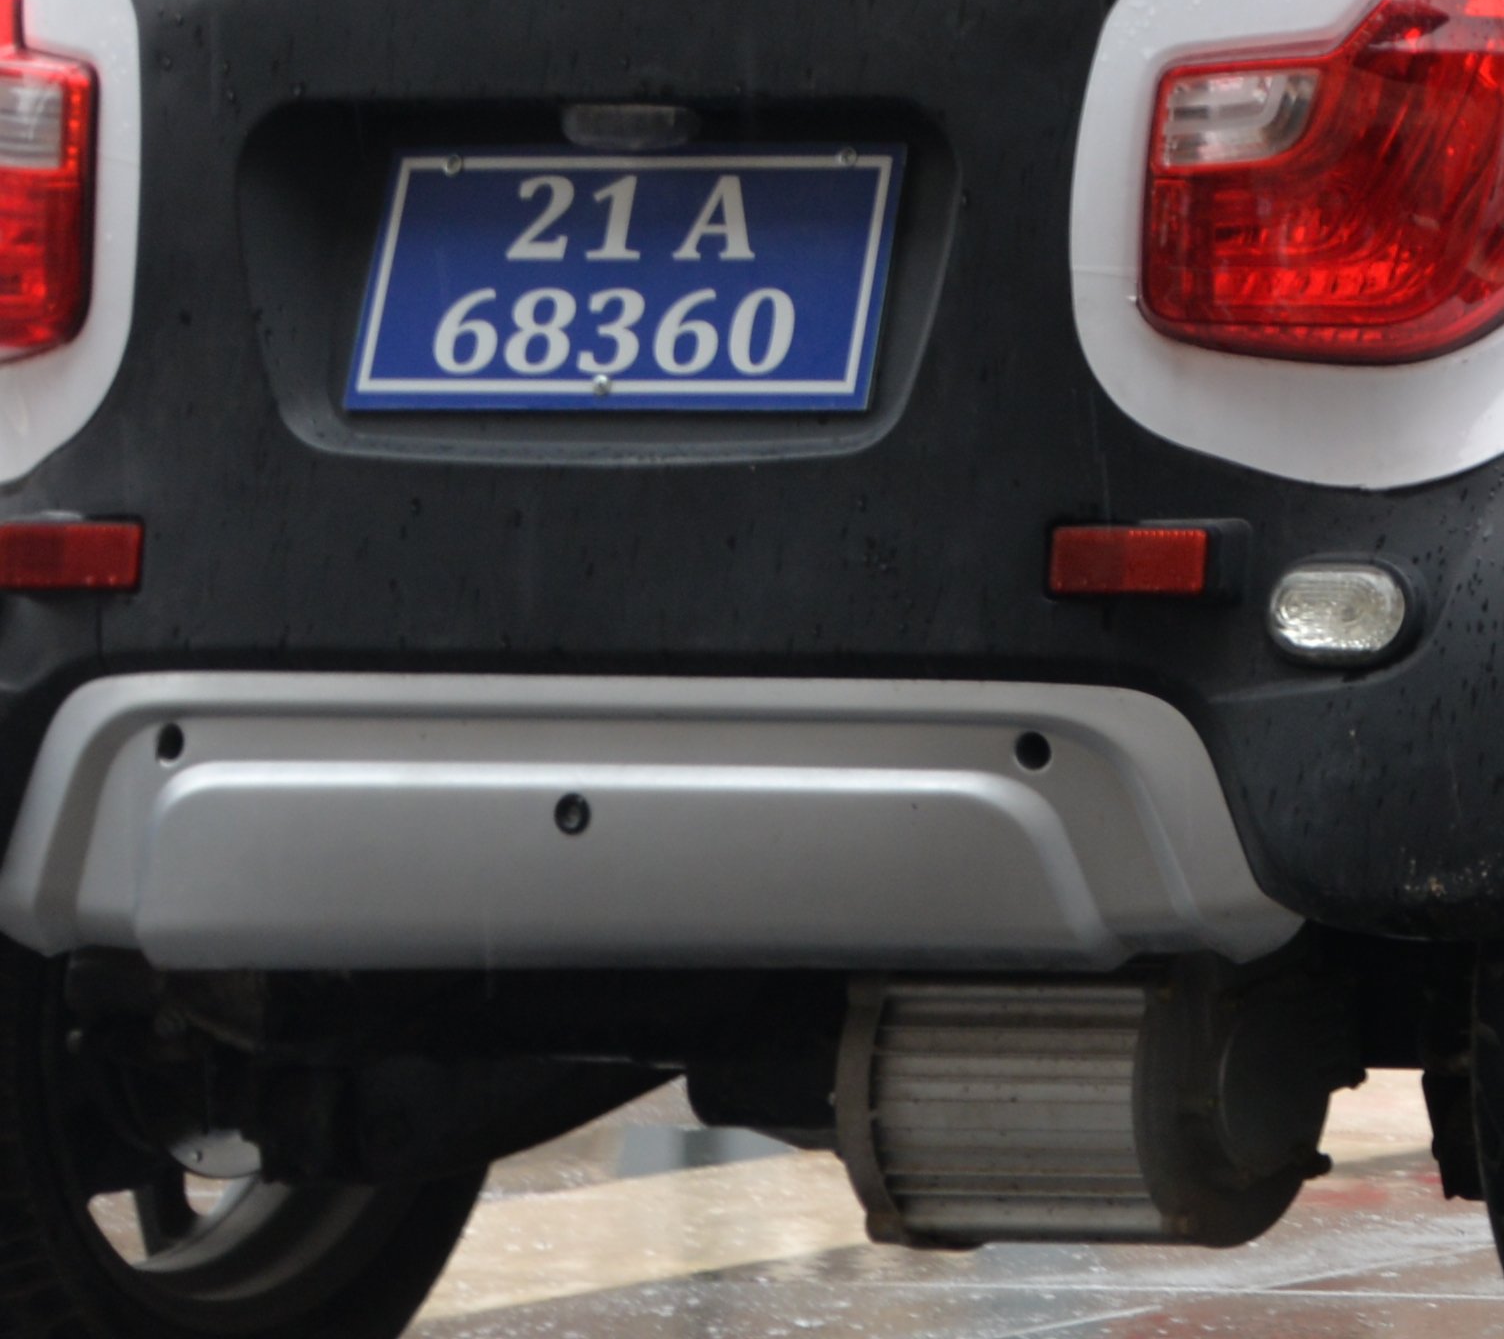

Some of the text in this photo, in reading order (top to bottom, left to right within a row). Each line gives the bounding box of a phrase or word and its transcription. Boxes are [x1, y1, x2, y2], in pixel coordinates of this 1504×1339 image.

[505, 174, 756, 261] 21 A
[432, 286, 797, 375] 68360
